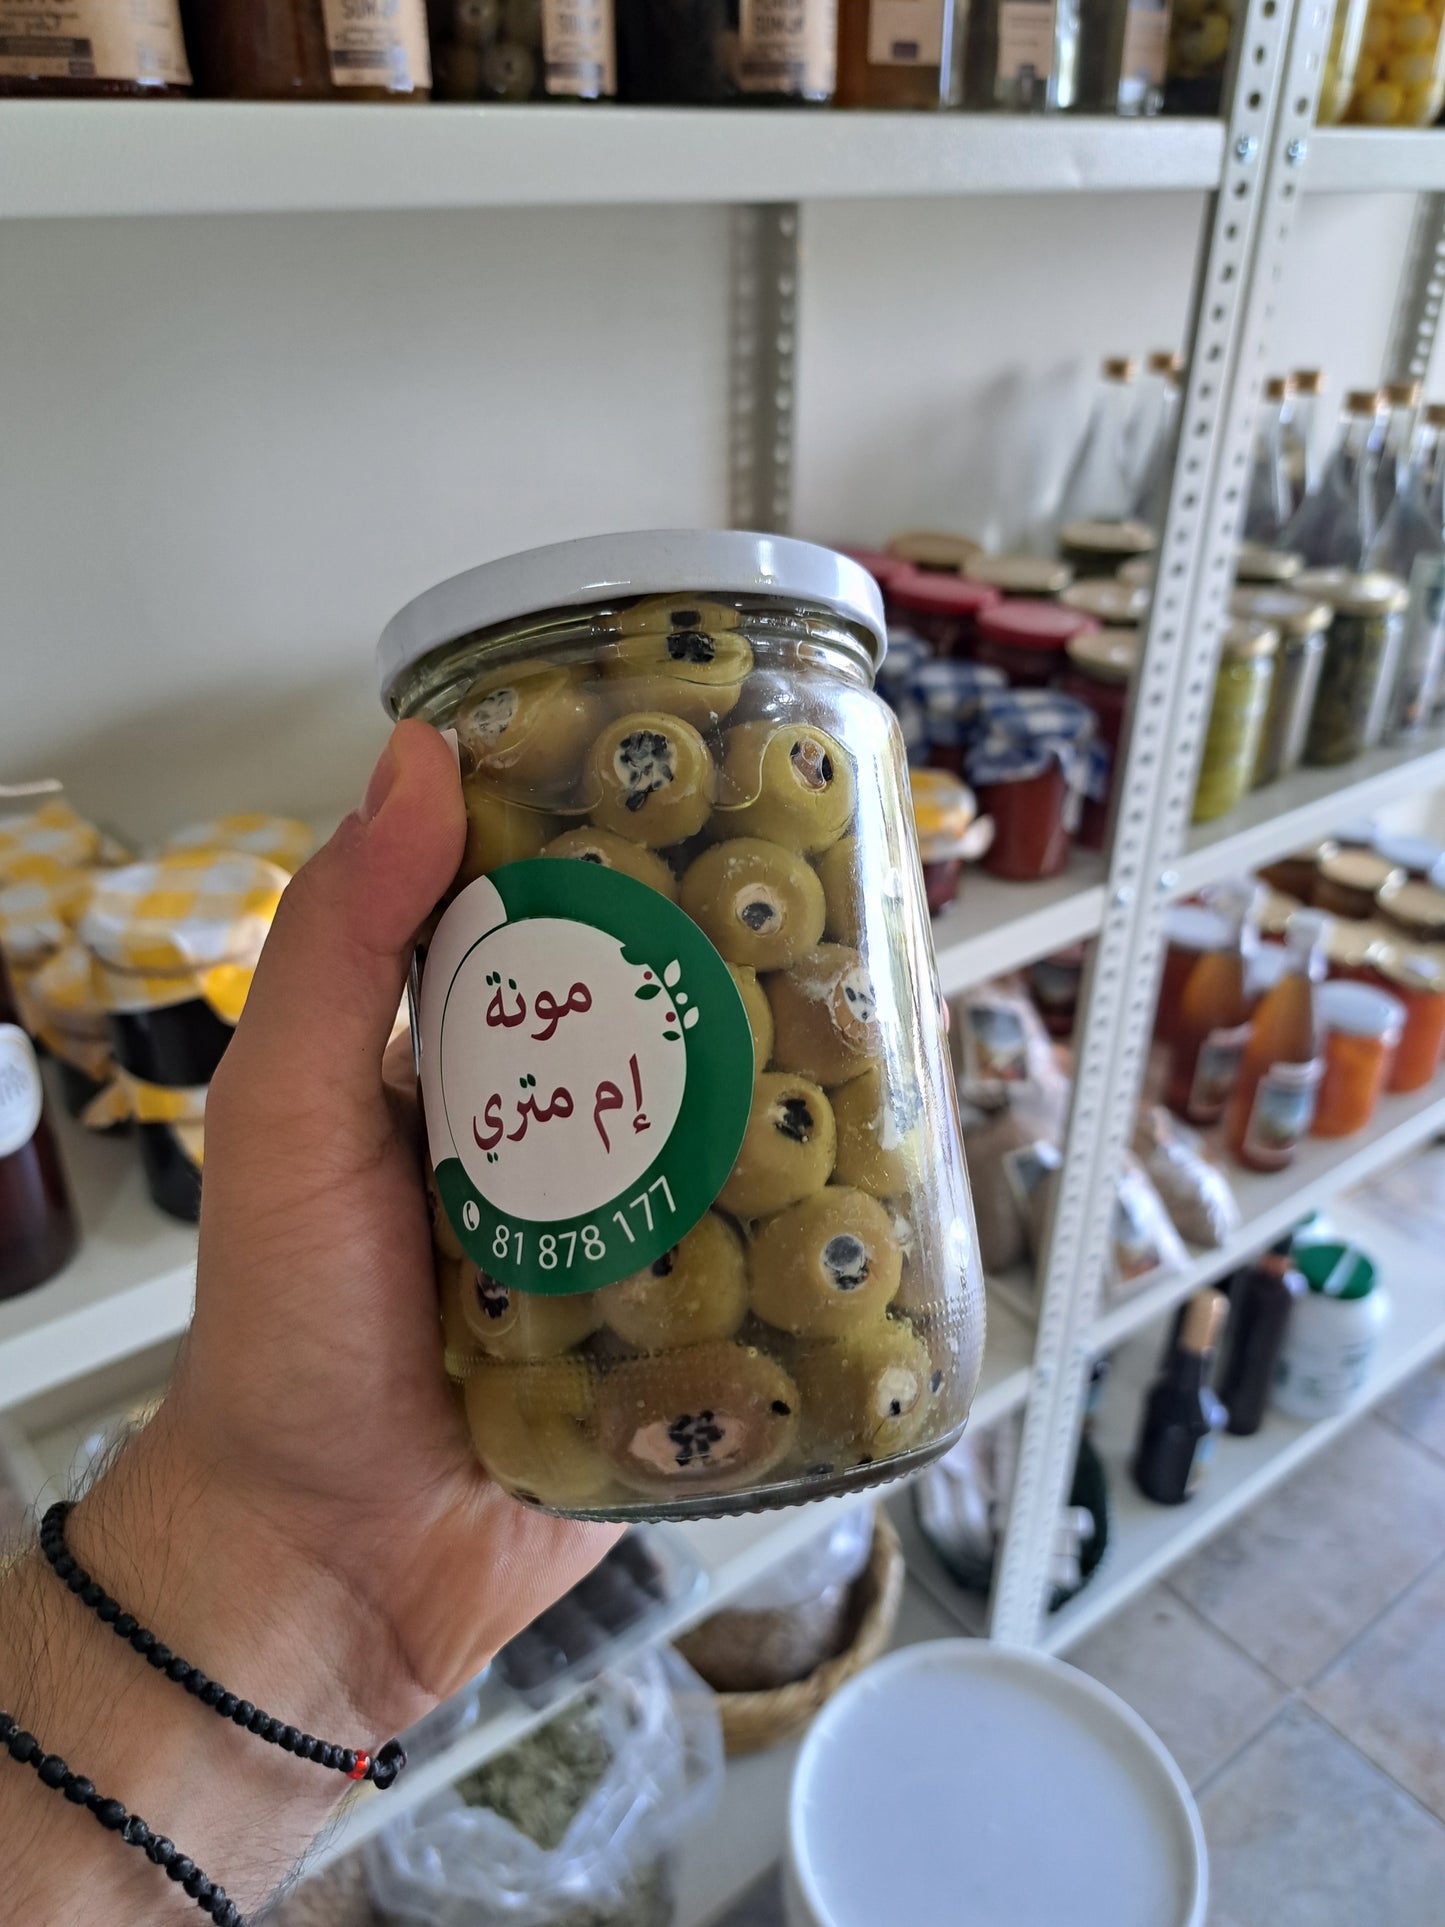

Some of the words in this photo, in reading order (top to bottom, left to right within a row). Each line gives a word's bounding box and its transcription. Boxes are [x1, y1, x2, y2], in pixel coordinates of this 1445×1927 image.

[486, 972, 592, 1041] مونة
[474, 1074, 574, 1163] متري
[594, 1054, 651, 1153] إم
[493, 1225, 524, 1265] 81
[538, 1225, 606, 1269] 878
[613, 1176, 676, 1243] 177
